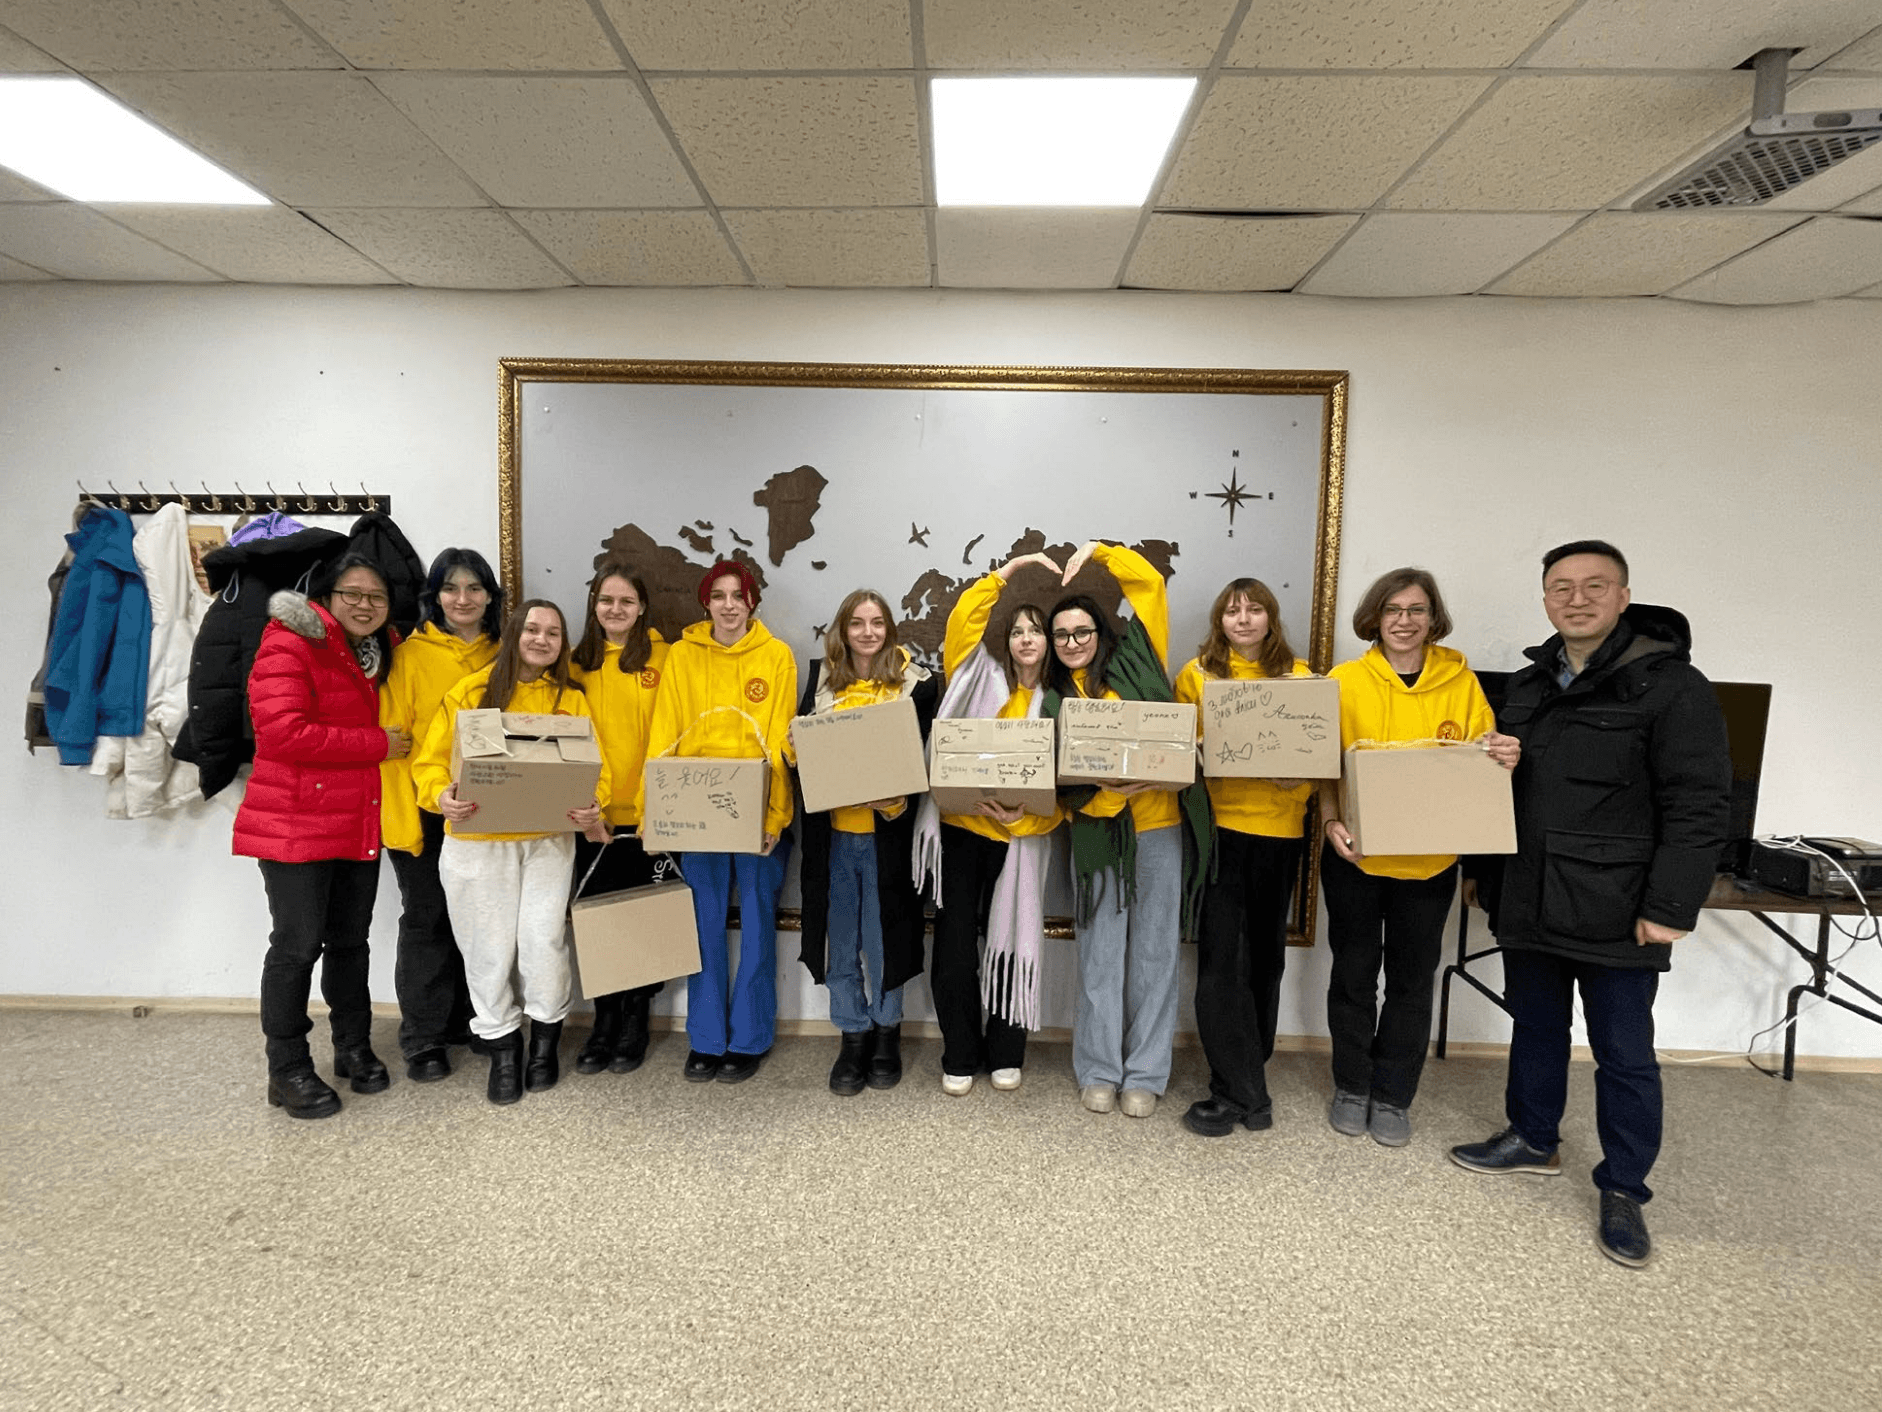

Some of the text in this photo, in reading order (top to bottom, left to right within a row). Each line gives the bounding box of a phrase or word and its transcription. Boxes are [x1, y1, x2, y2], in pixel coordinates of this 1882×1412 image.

[1232, 449, 1240, 458] N
[1189, 491, 1198, 500] W
[1268, 491, 1274, 500] E
[1227, 529, 1234, 538] S
